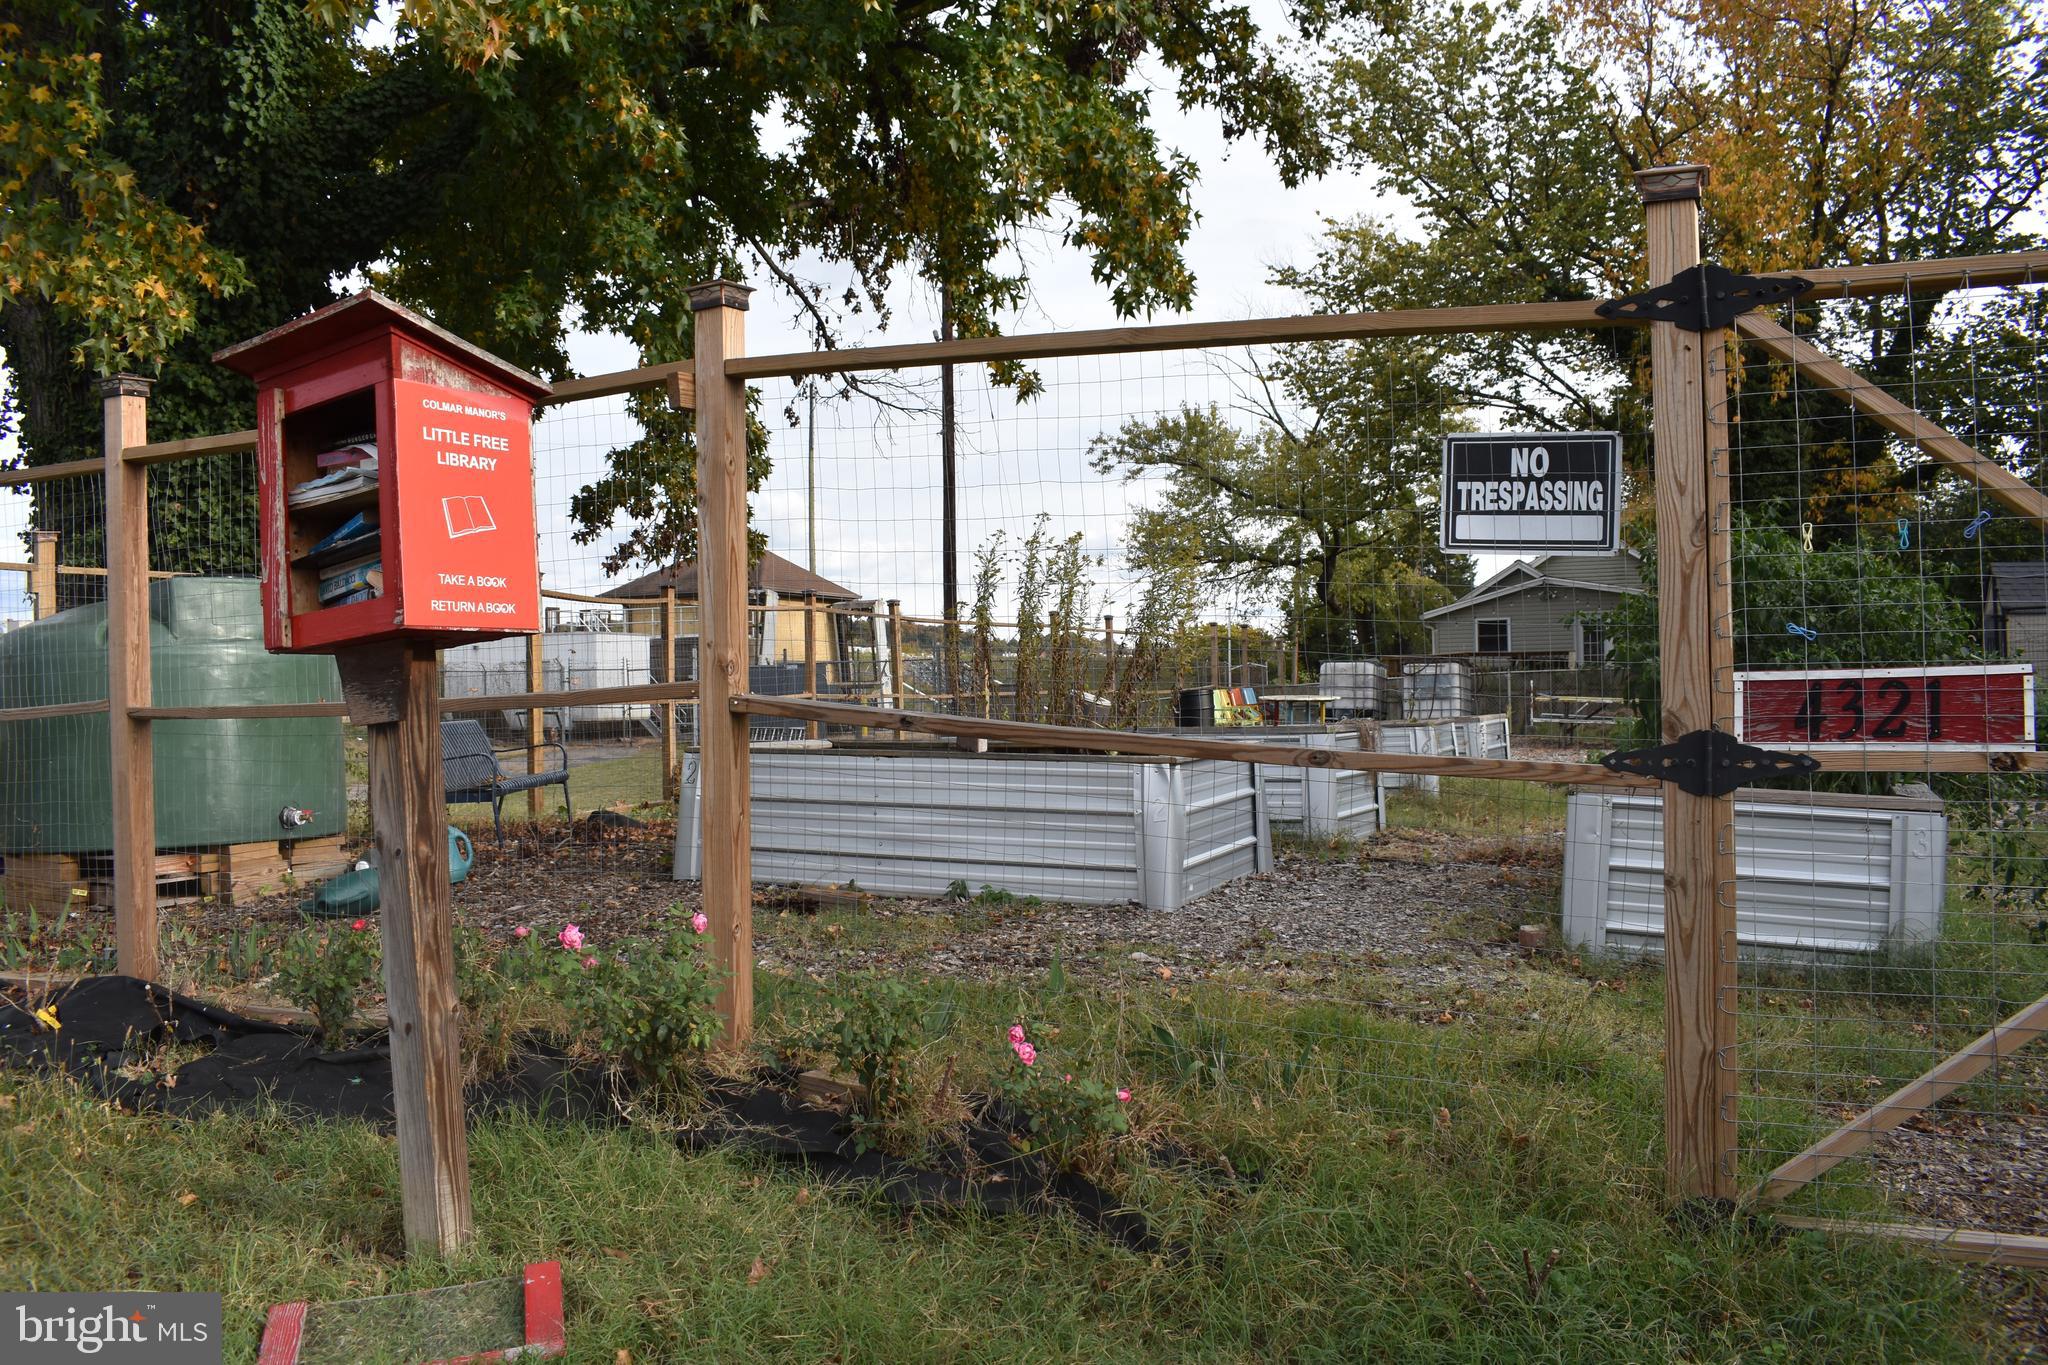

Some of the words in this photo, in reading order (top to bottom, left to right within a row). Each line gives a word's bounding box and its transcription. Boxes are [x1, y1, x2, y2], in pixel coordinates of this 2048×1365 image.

[422, 399, 463, 415] COLMAR
[464, 406, 507, 421] MANOR'S
[422, 426, 470, 446] LITTLE
[473, 434, 509, 451] FREE
[437, 451, 497, 471] LIBRARY
[1510, 446, 1550, 478] NO
[1457, 480, 1604, 511] TRESPASSING
[437, 573, 466, 586] TAKE
[467, 575, 476, 587] A
[477, 576, 507, 588] BOOK
[431, 600, 476, 613] RETURN
[477, 602, 485, 613] A
[486, 602, 516, 614] BOOK
[1794, 678, 1942, 741] 4321
[685, 760, 697, 785] 2
